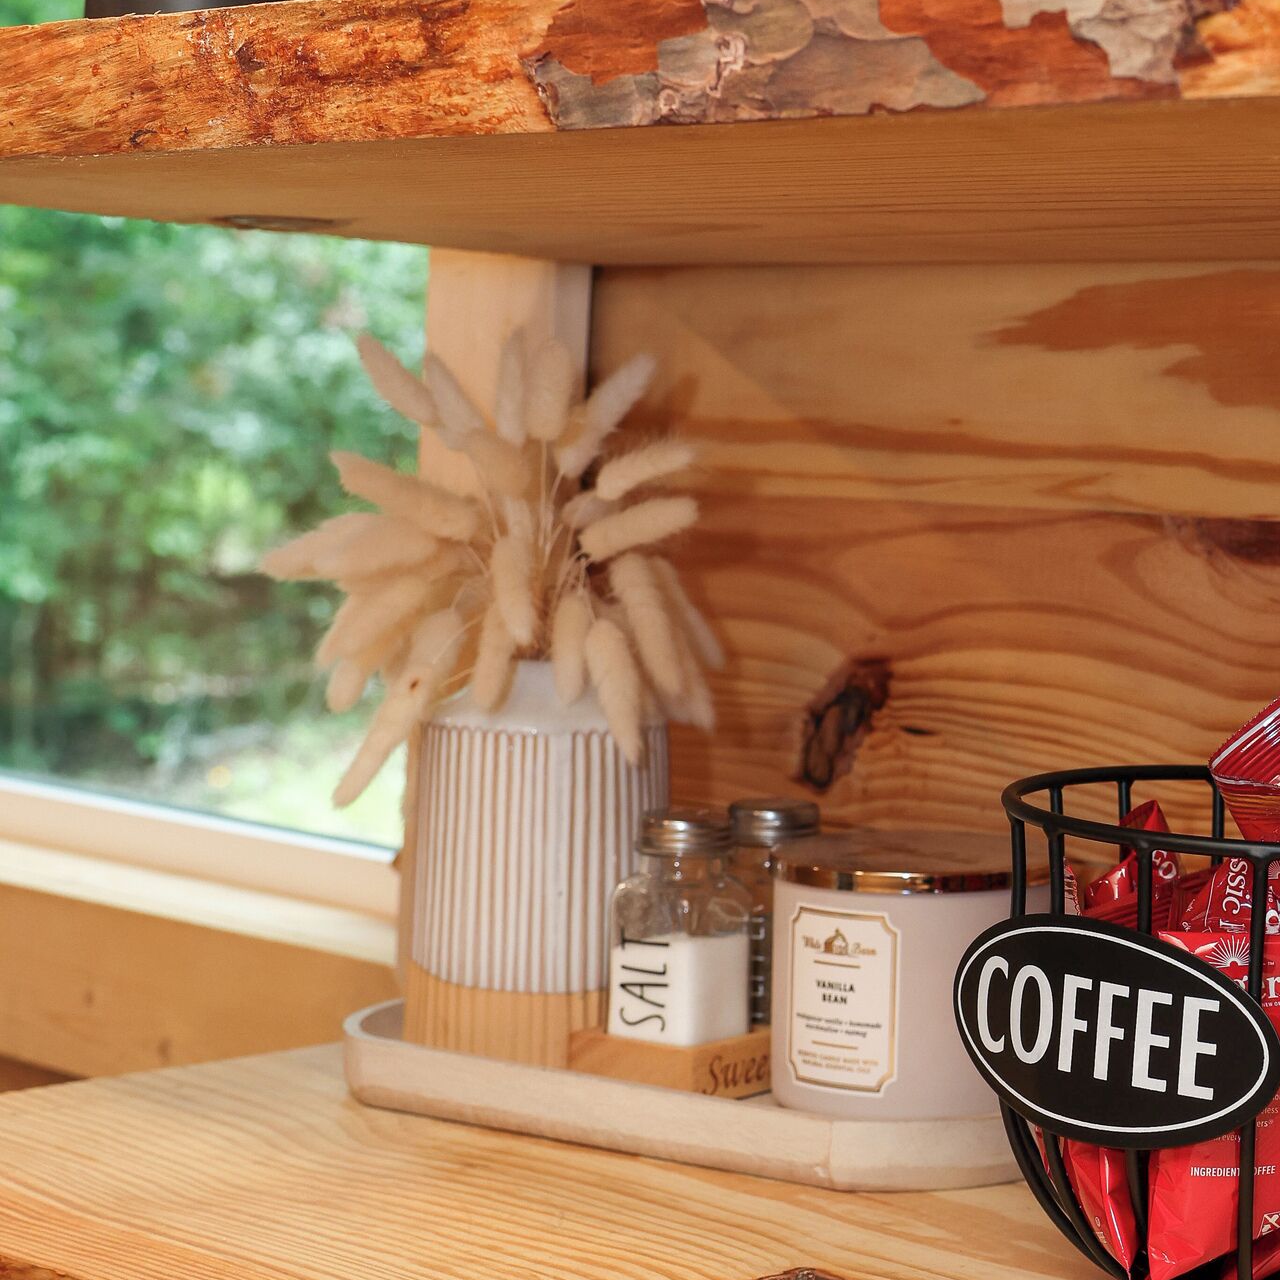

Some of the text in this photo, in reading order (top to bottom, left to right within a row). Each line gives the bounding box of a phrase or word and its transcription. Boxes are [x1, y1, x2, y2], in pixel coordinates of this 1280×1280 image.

[1222, 857, 1250, 915] ssic
[619, 926, 671, 1032] SALT
[815, 979, 856, 993] VANILLA
[821, 993, 848, 1005] BEAN
[976, 954, 1220, 1101] COFFEE
[702, 1054, 771, 1097] Swee
